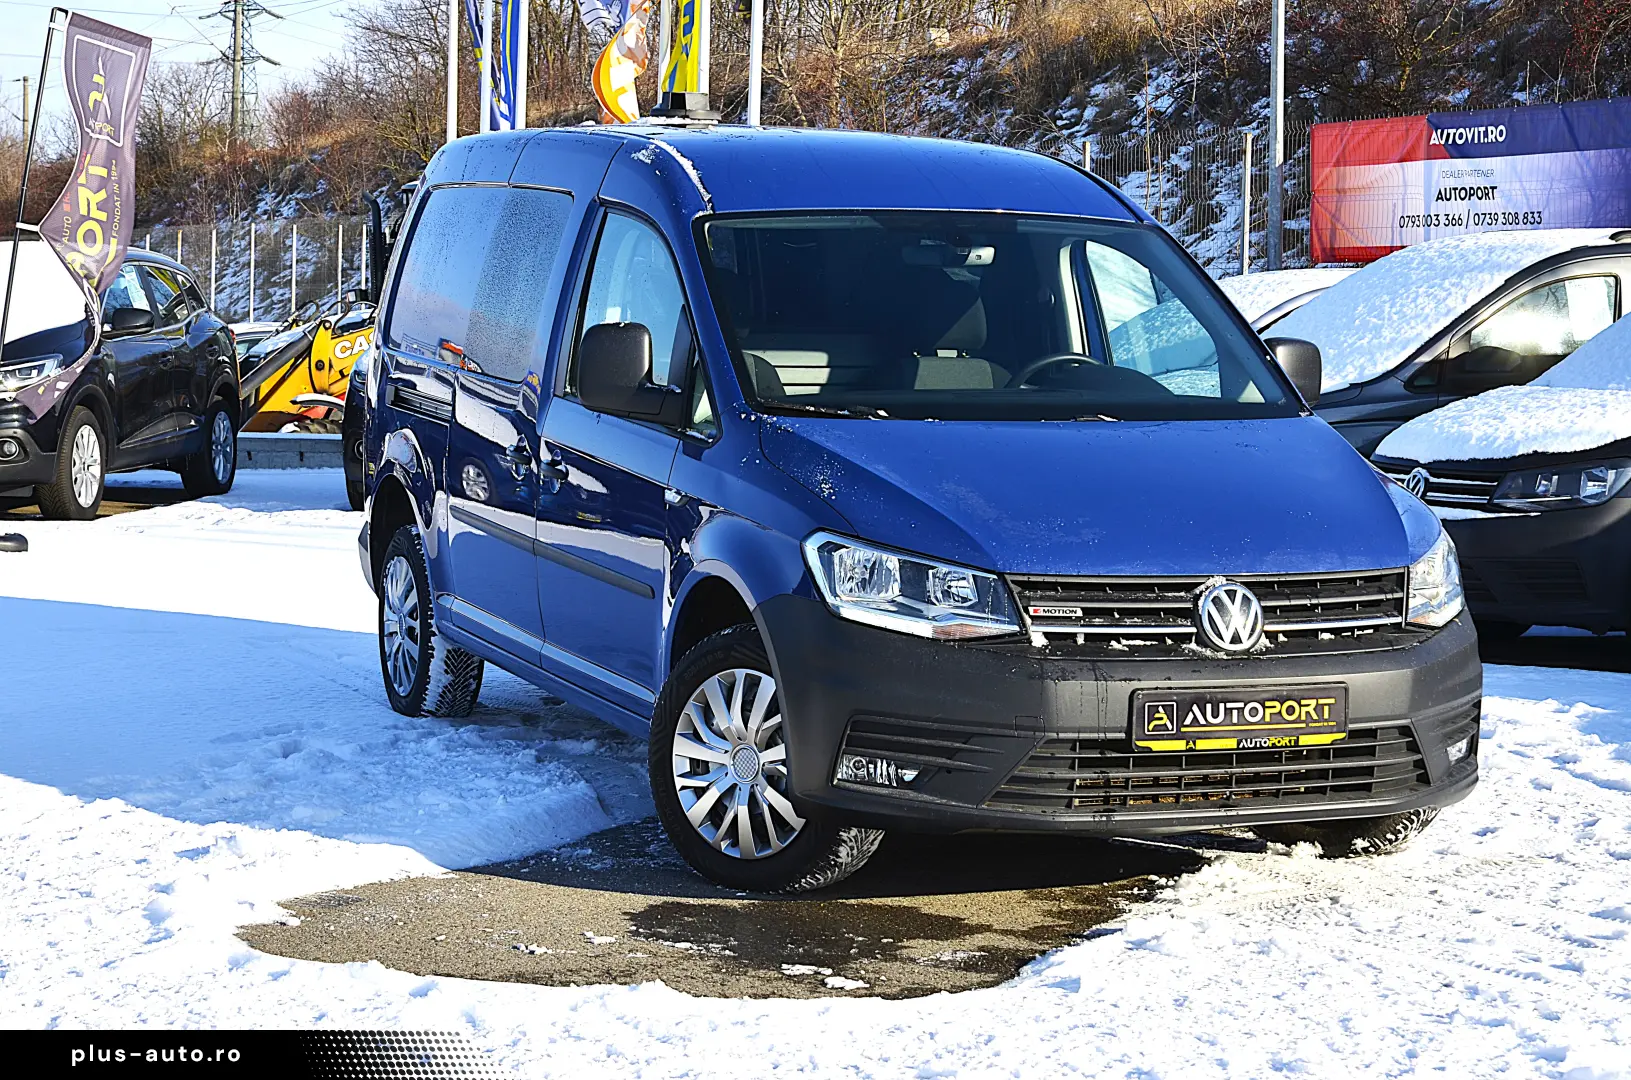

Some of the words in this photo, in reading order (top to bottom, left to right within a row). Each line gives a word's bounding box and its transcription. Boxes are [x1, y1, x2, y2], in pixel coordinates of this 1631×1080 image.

[1430, 124, 1506, 146] AUTOVIT.RO
[1441, 169, 1464, 179] DEALER
[112, 183, 121, 194] IN
[1435, 185, 1498, 202] AUTOPORT
[111, 195, 121, 237] FONDAT
[1443, 213, 1463, 227] 366
[1473, 212, 1499, 227] 0739
[1501, 212, 1520, 226] 308
[1522, 211, 1543, 225] 833
[62, 216, 73, 244] AUTO
[1183, 697, 1336, 726] AUTOPORT
[1239, 737, 1298, 749] AUTOPORT
